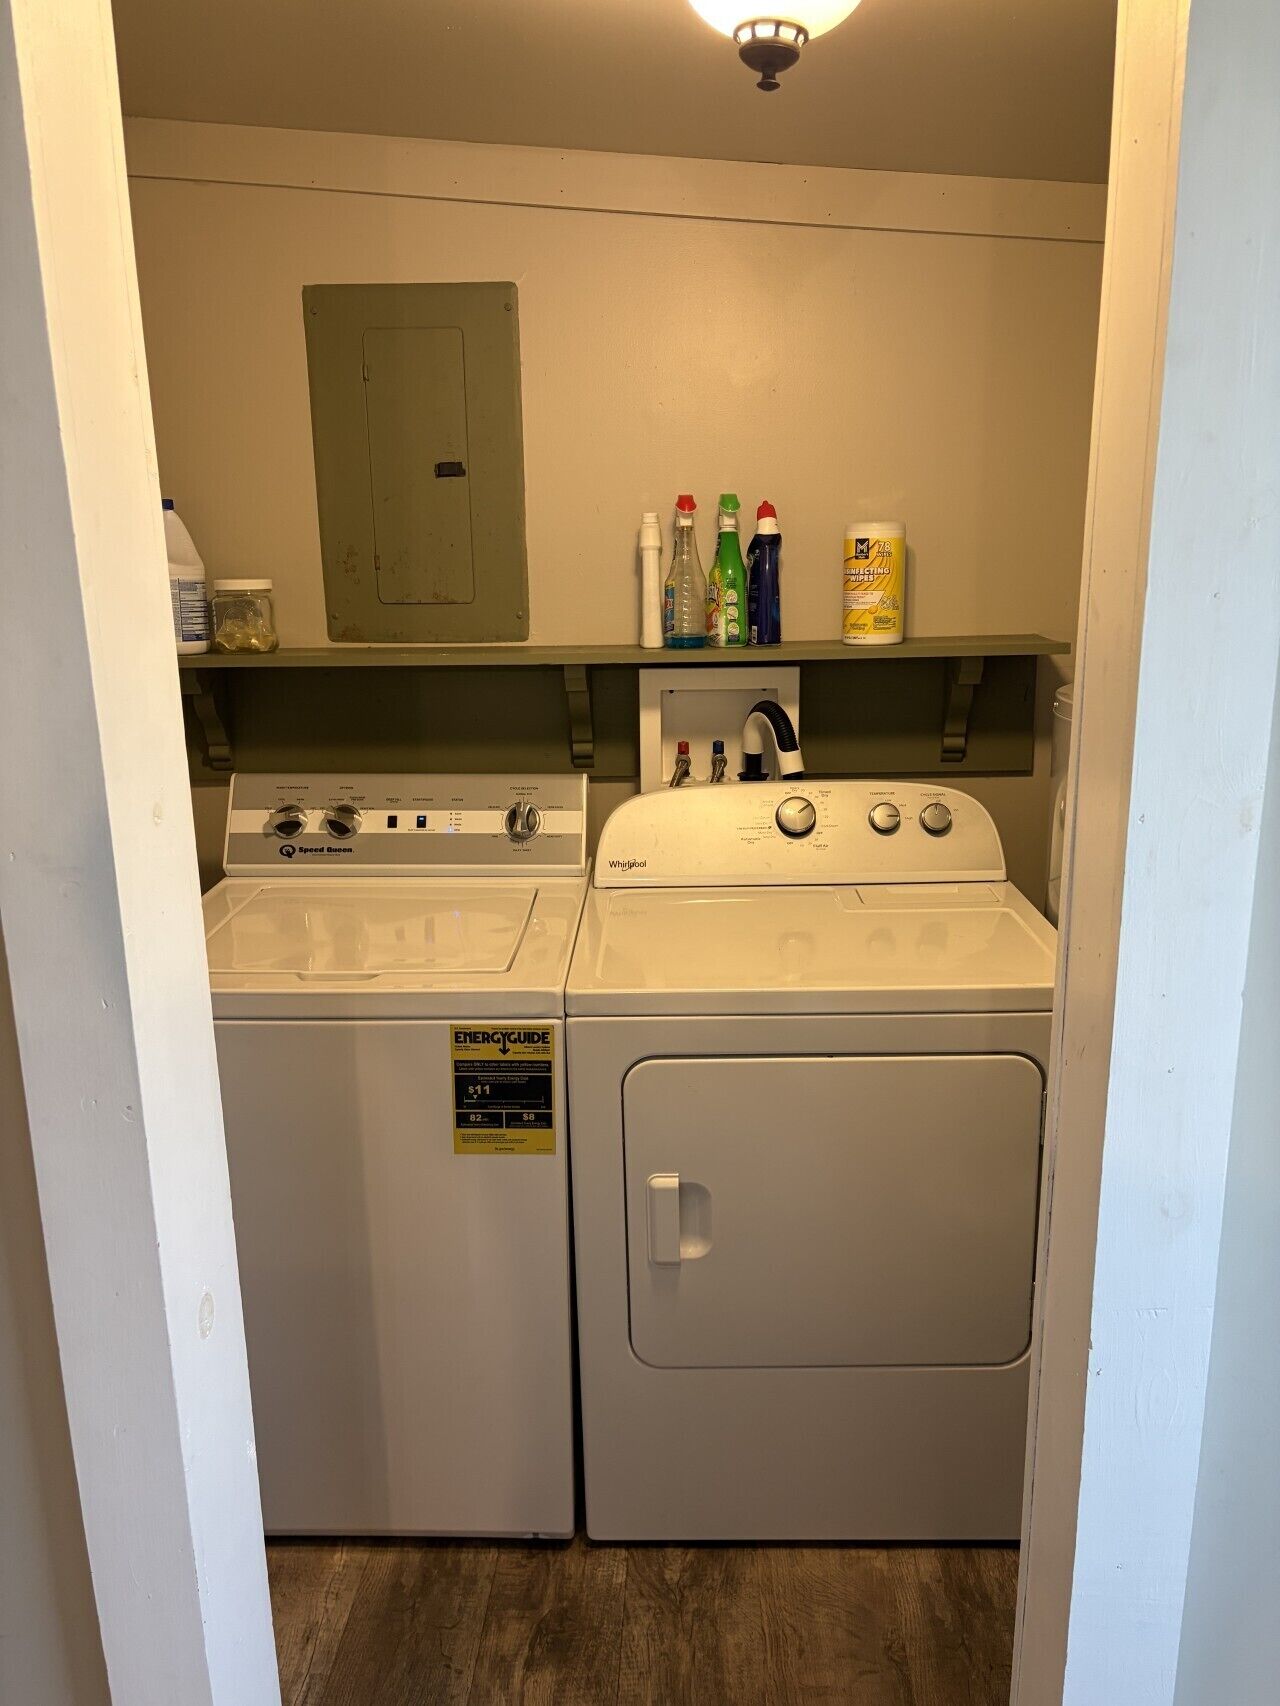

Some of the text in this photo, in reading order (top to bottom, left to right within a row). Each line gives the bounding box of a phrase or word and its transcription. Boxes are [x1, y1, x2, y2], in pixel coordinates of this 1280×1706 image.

[878, 541, 891, 552] 78
[298, 846, 325, 854] Speed
[608, 859, 647, 872] Whirlpool
[454, 1031, 551, 1045] ENERGYGUIDE
[468, 1084, 490, 1095] $11
[469, 1114, 482, 1122] 82
[522, 1112, 535, 1121] $8
